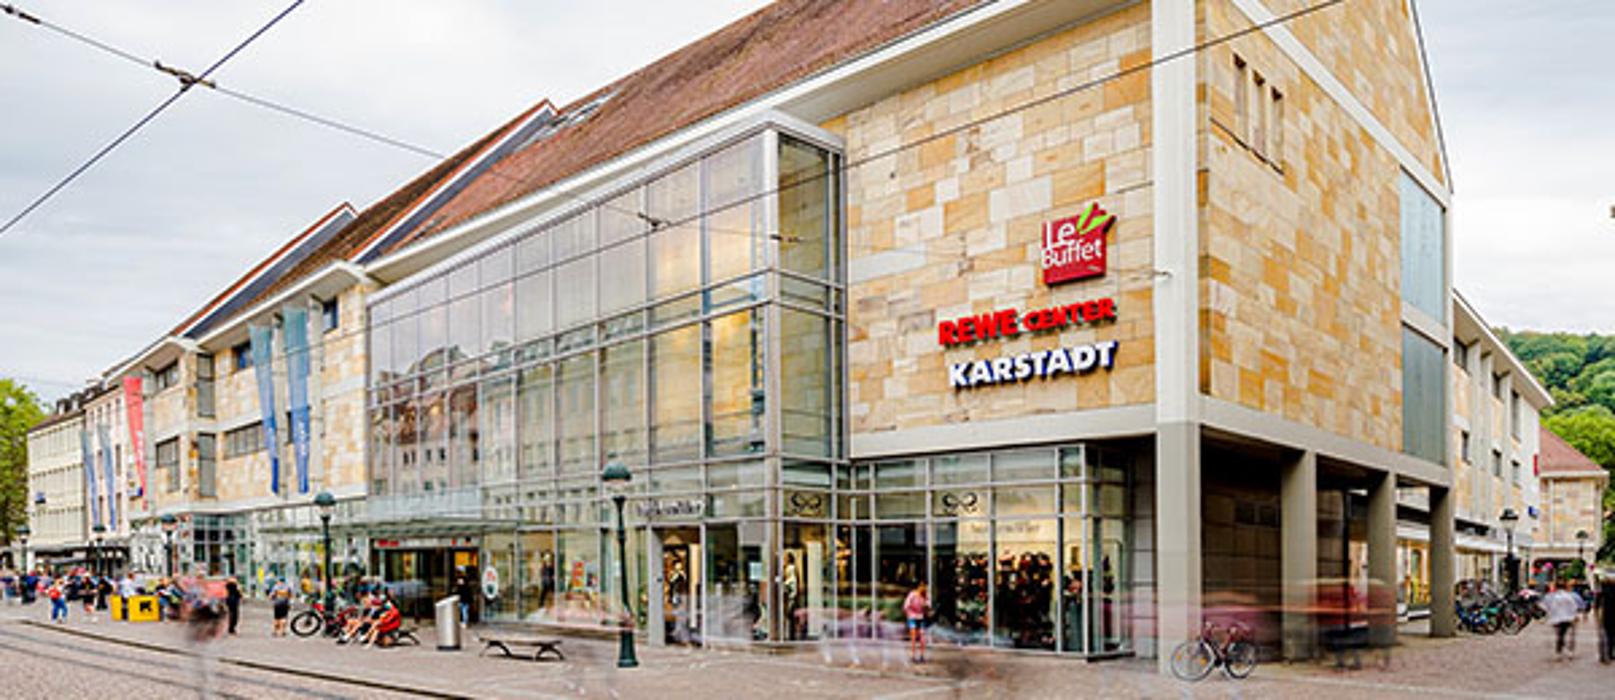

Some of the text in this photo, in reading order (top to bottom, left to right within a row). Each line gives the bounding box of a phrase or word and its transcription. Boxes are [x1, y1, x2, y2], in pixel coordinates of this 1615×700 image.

[1040, 239, 1103, 268] Buffet
[1045, 221, 1076, 250] Le
[938, 297, 1116, 346] REWE CENTER
[949, 340, 1118, 387] KARSTADT
